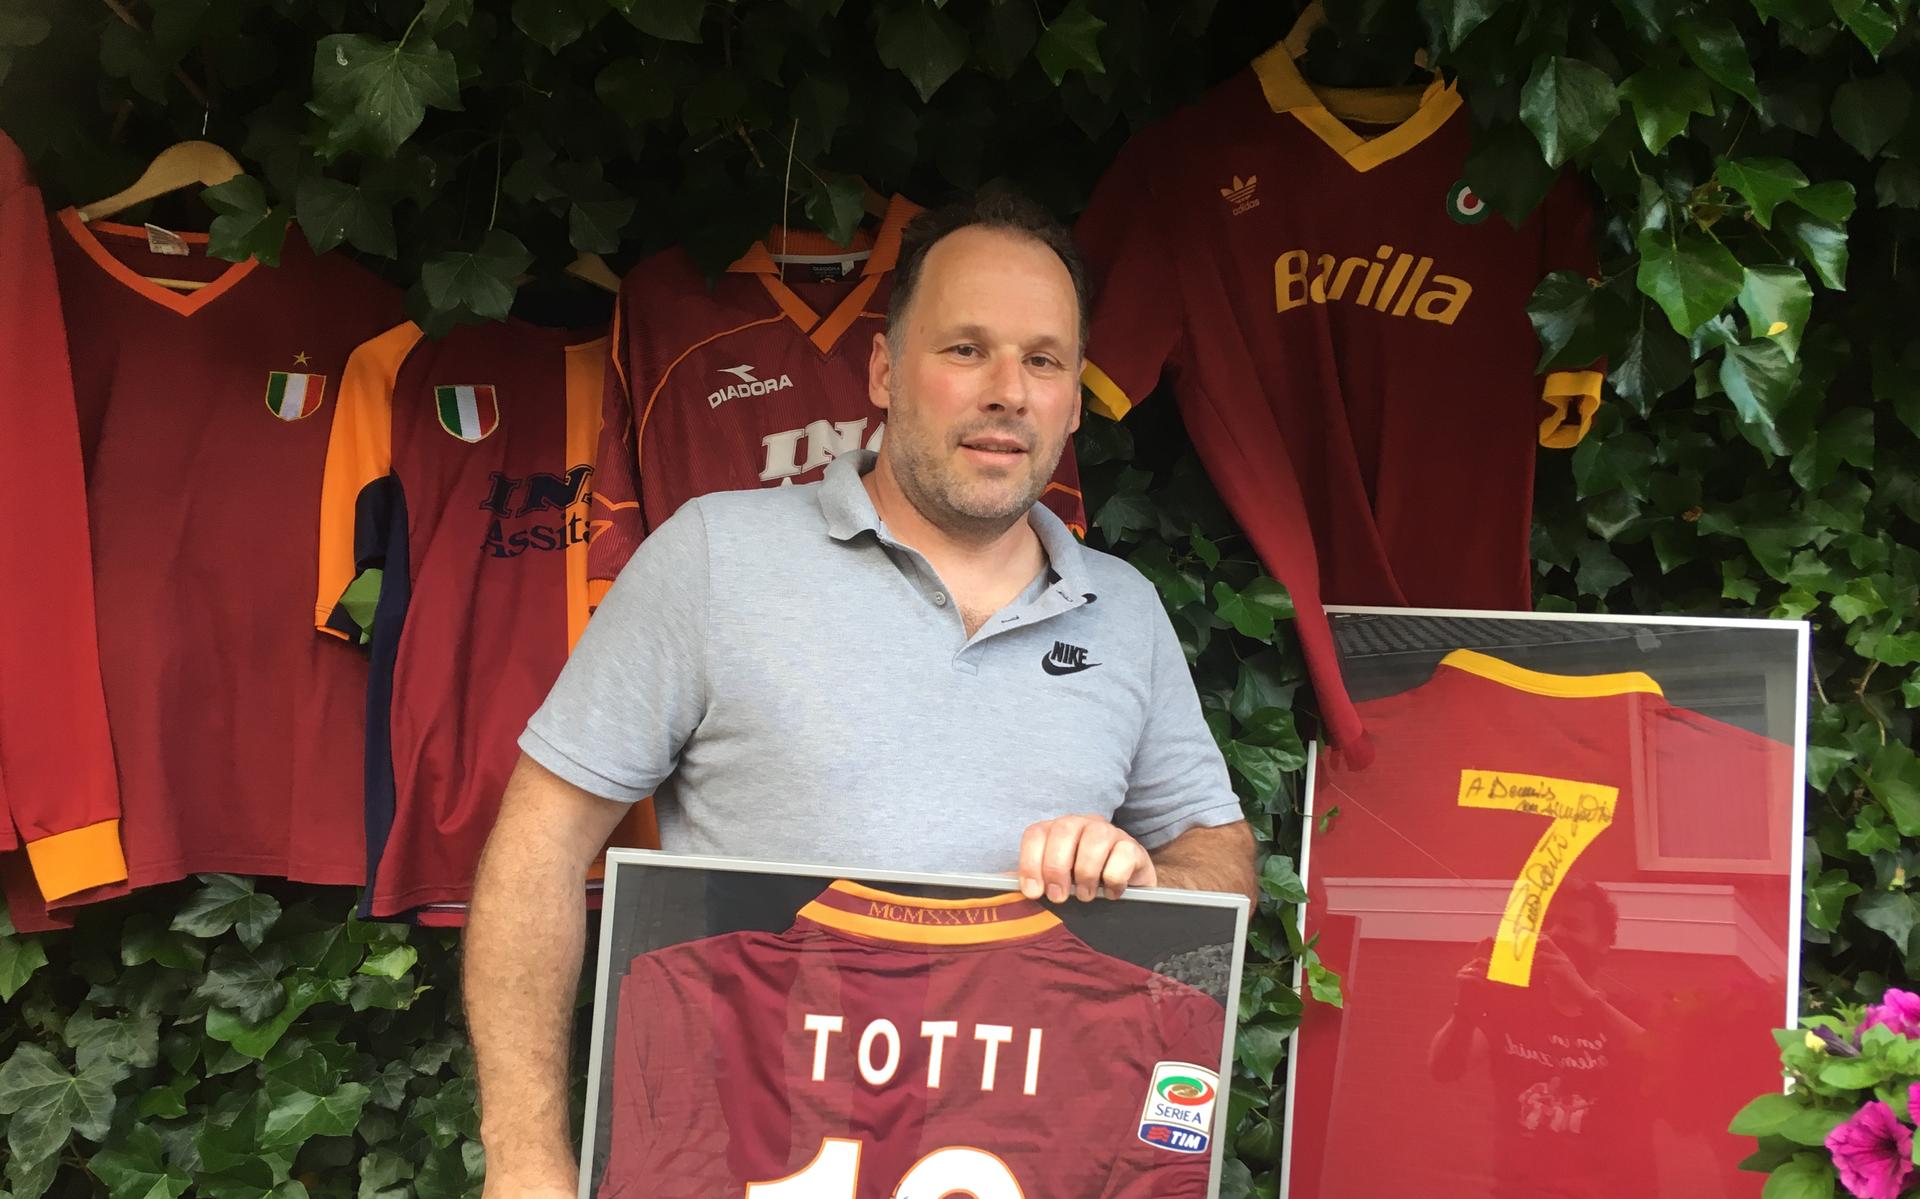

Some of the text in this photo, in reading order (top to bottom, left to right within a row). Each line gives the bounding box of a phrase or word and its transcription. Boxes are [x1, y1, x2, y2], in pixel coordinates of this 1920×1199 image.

[1232, 199, 1260, 216] adidas
[1274, 244, 1473, 325] Barilla
[708, 374, 794, 409] DIADORA
[759, 417, 885, 481] IN
[480, 464, 594, 518] IN
[1051, 641, 1088, 666] NIKE
[1466, 777, 1485, 798] A
[1458, 769, 1619, 987] 7
[869, 901, 998, 925] MCMXXVII
[804, 1014, 1043, 1095] TOTTI
[1155, 1103, 1202, 1124] SERIE A
[1171, 1130, 1202, 1150] TIM
